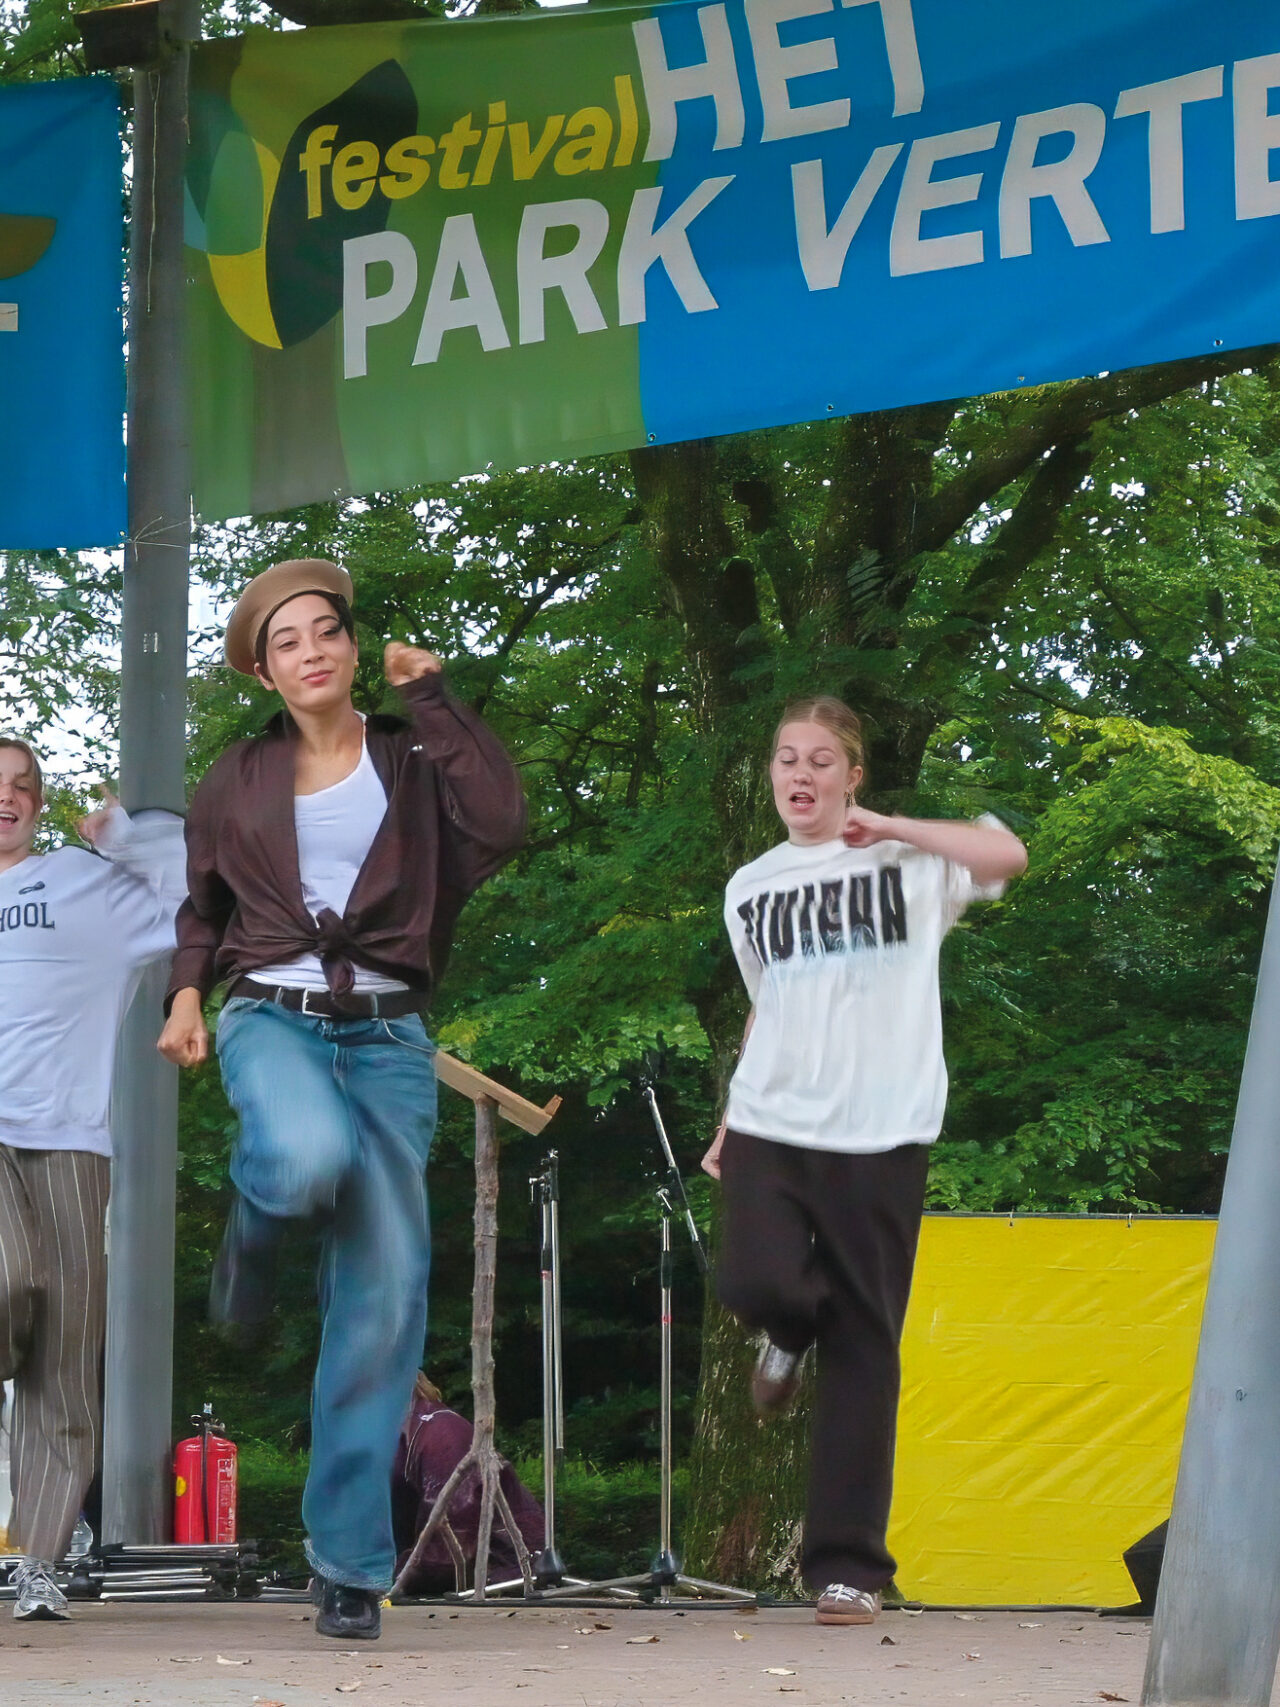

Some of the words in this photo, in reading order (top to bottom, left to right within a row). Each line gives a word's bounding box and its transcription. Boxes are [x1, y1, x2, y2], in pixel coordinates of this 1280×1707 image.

[299, 74, 639, 220] festival
[632, 0, 926, 163] HET
[343, 174, 736, 380] PARK
